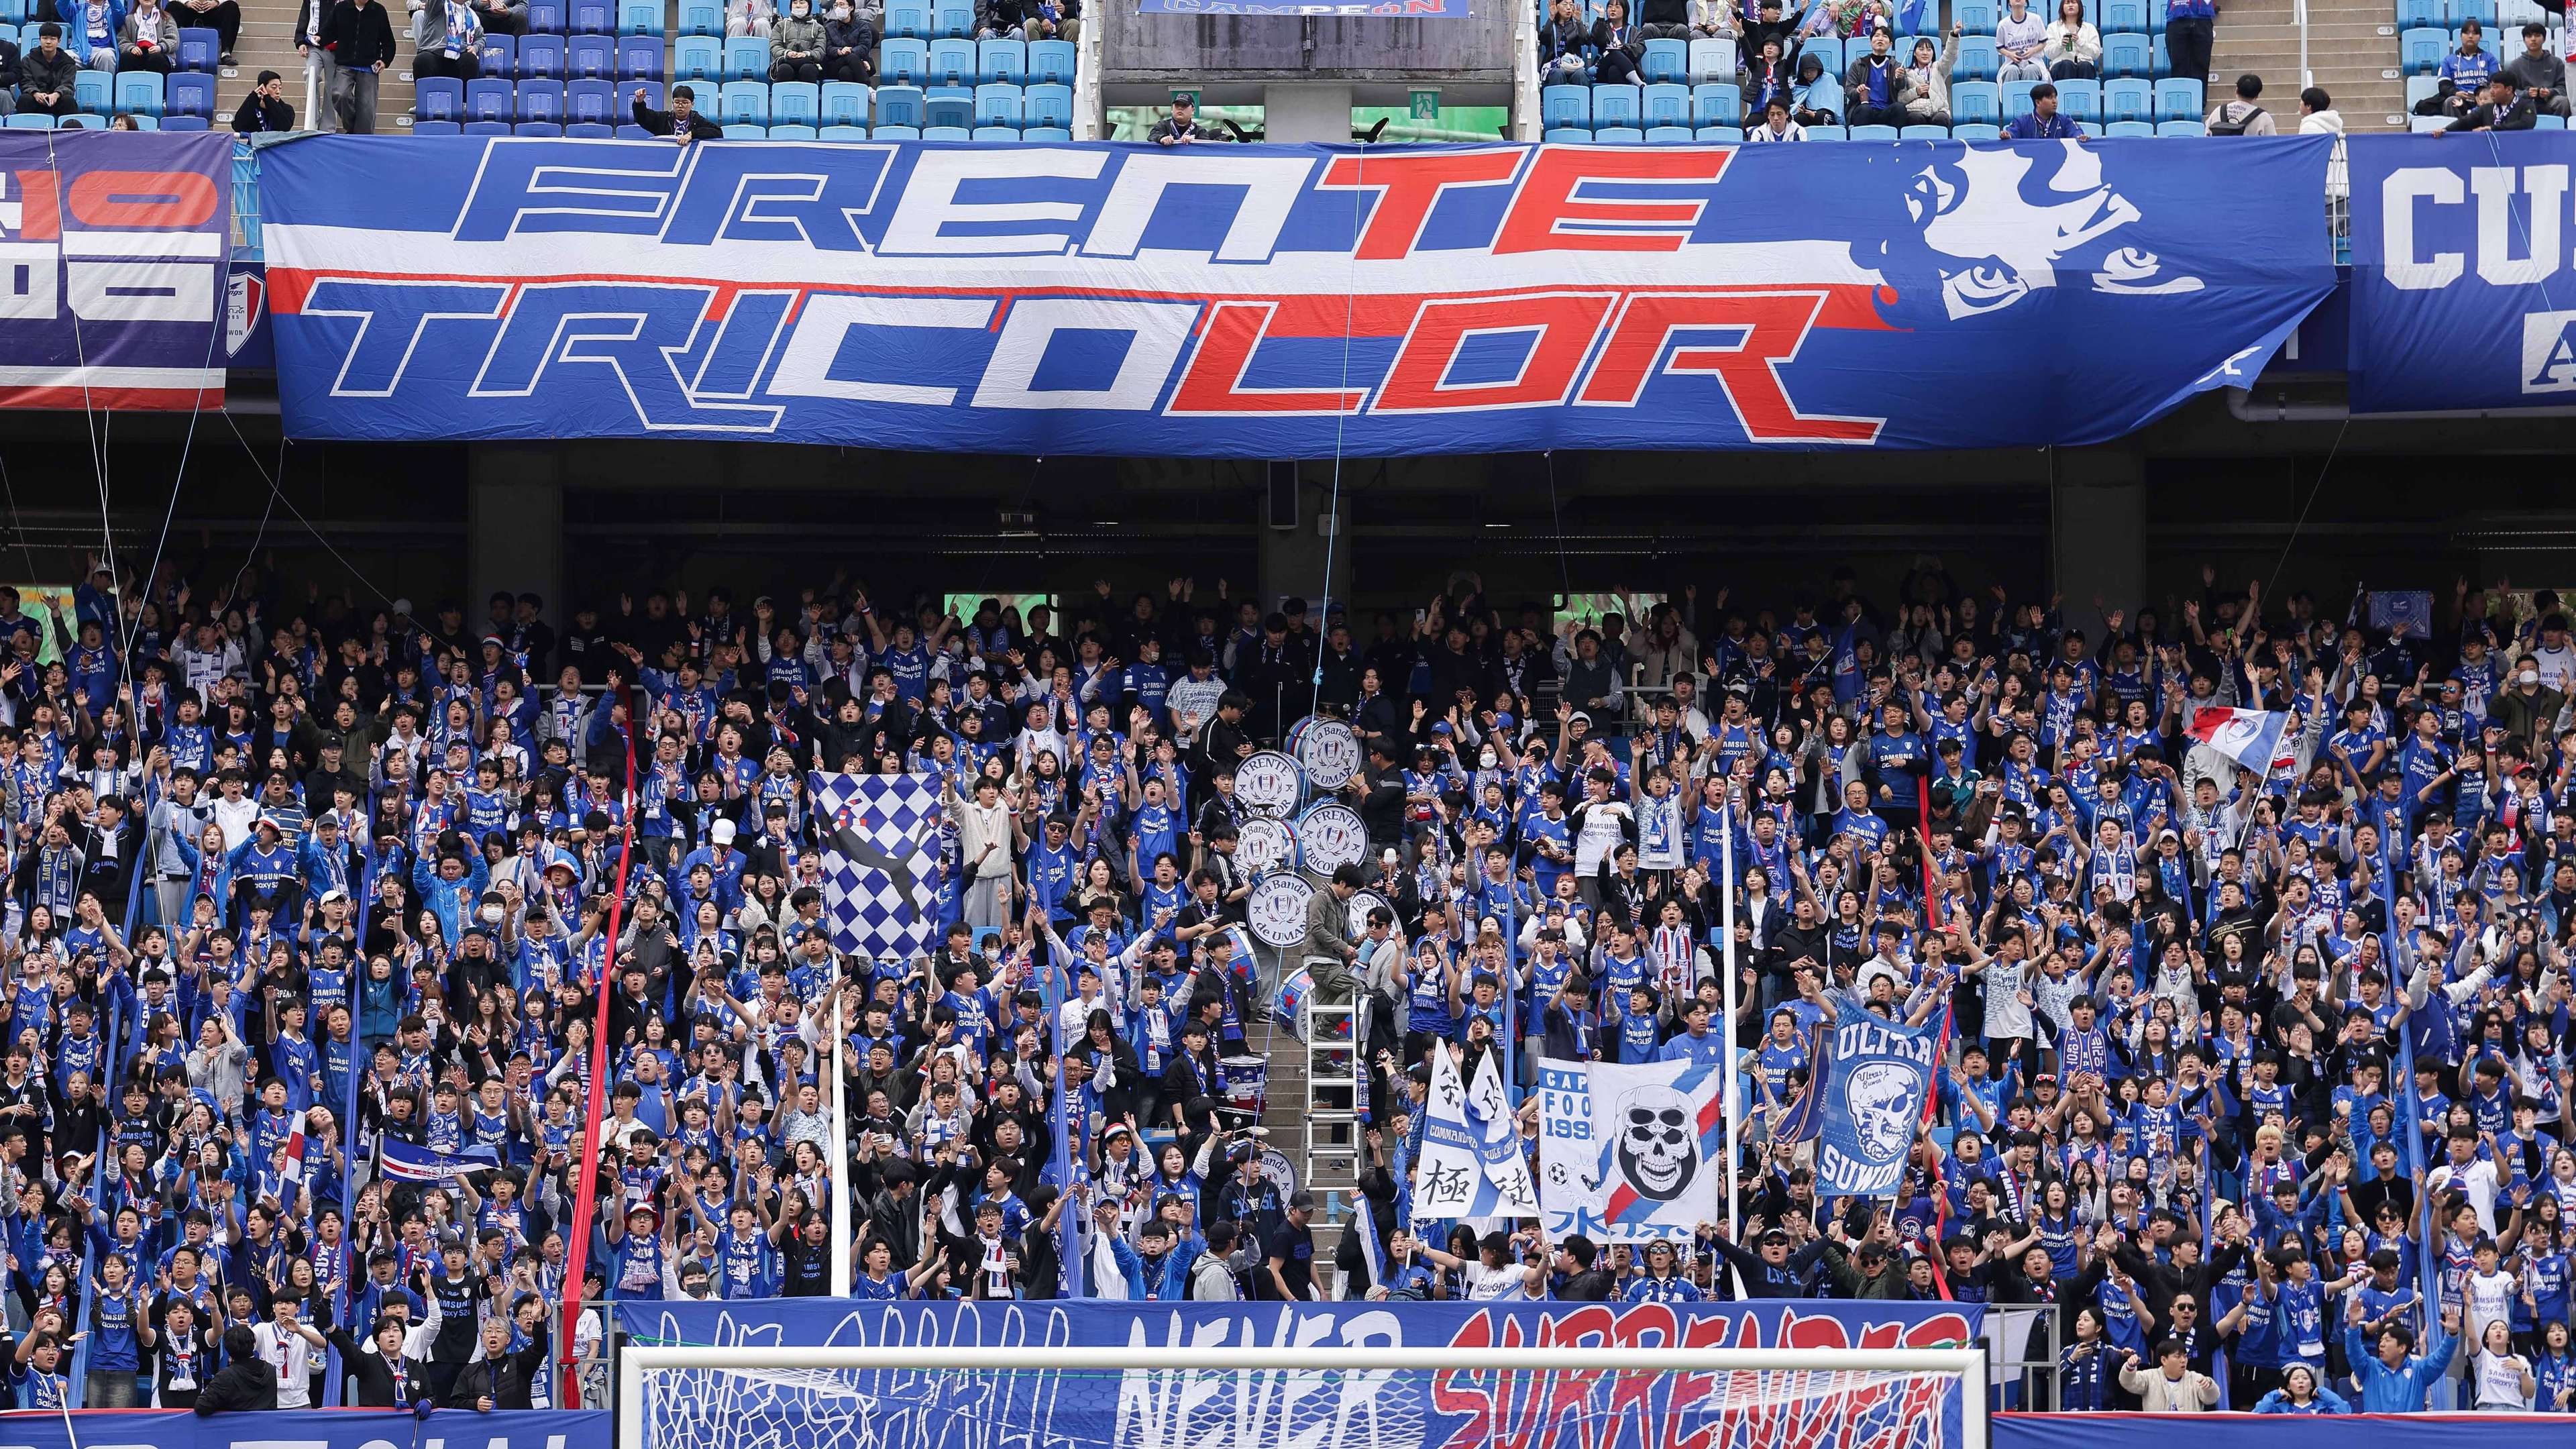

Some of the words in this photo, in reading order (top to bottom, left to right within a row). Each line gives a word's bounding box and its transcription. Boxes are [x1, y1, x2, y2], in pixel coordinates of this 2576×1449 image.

[2008, 39, 2035, 48] SAMSUNG
[2454, 70, 2489, 78] SAMSUNG
[448, 137, 1741, 262] FRENTE
[300, 276, 1886, 445] TRICOLOR
[893, 662, 922, 672] SAMSUNG
[893, 672, 913, 680] Galaxy
[1311, 733, 1323, 745] La
[1324, 727, 1351, 743] Banda
[1242, 757, 1291, 776] FRENTE
[472, 809, 503, 817] SAMSUNG
[470, 817, 492, 826] Galaxy
[1313, 810, 1362, 836] FRENTE
[1246, 825, 1274, 839] Banda
[1846, 824, 1878, 840] SAMSUNG
[1256, 883, 1272, 898] La
[1272, 879, 1307, 898] Banda
[1256, 922, 1270, 938] de
[1837, 1022, 1937, 1067] ULTRA
[1546, 1118, 1595, 1140] 199
[1820, 1143, 1906, 1192] SUWON
[2043, 1231, 2074, 1239] SAMSUNG
[2041, 1240, 2063, 1248] Galaxy
[1114, 1303, 1403, 1449] NEVER
[1431, 1303, 1972, 1449] SURRENDER
[2487, 1378, 2511, 1388] Galaxy
